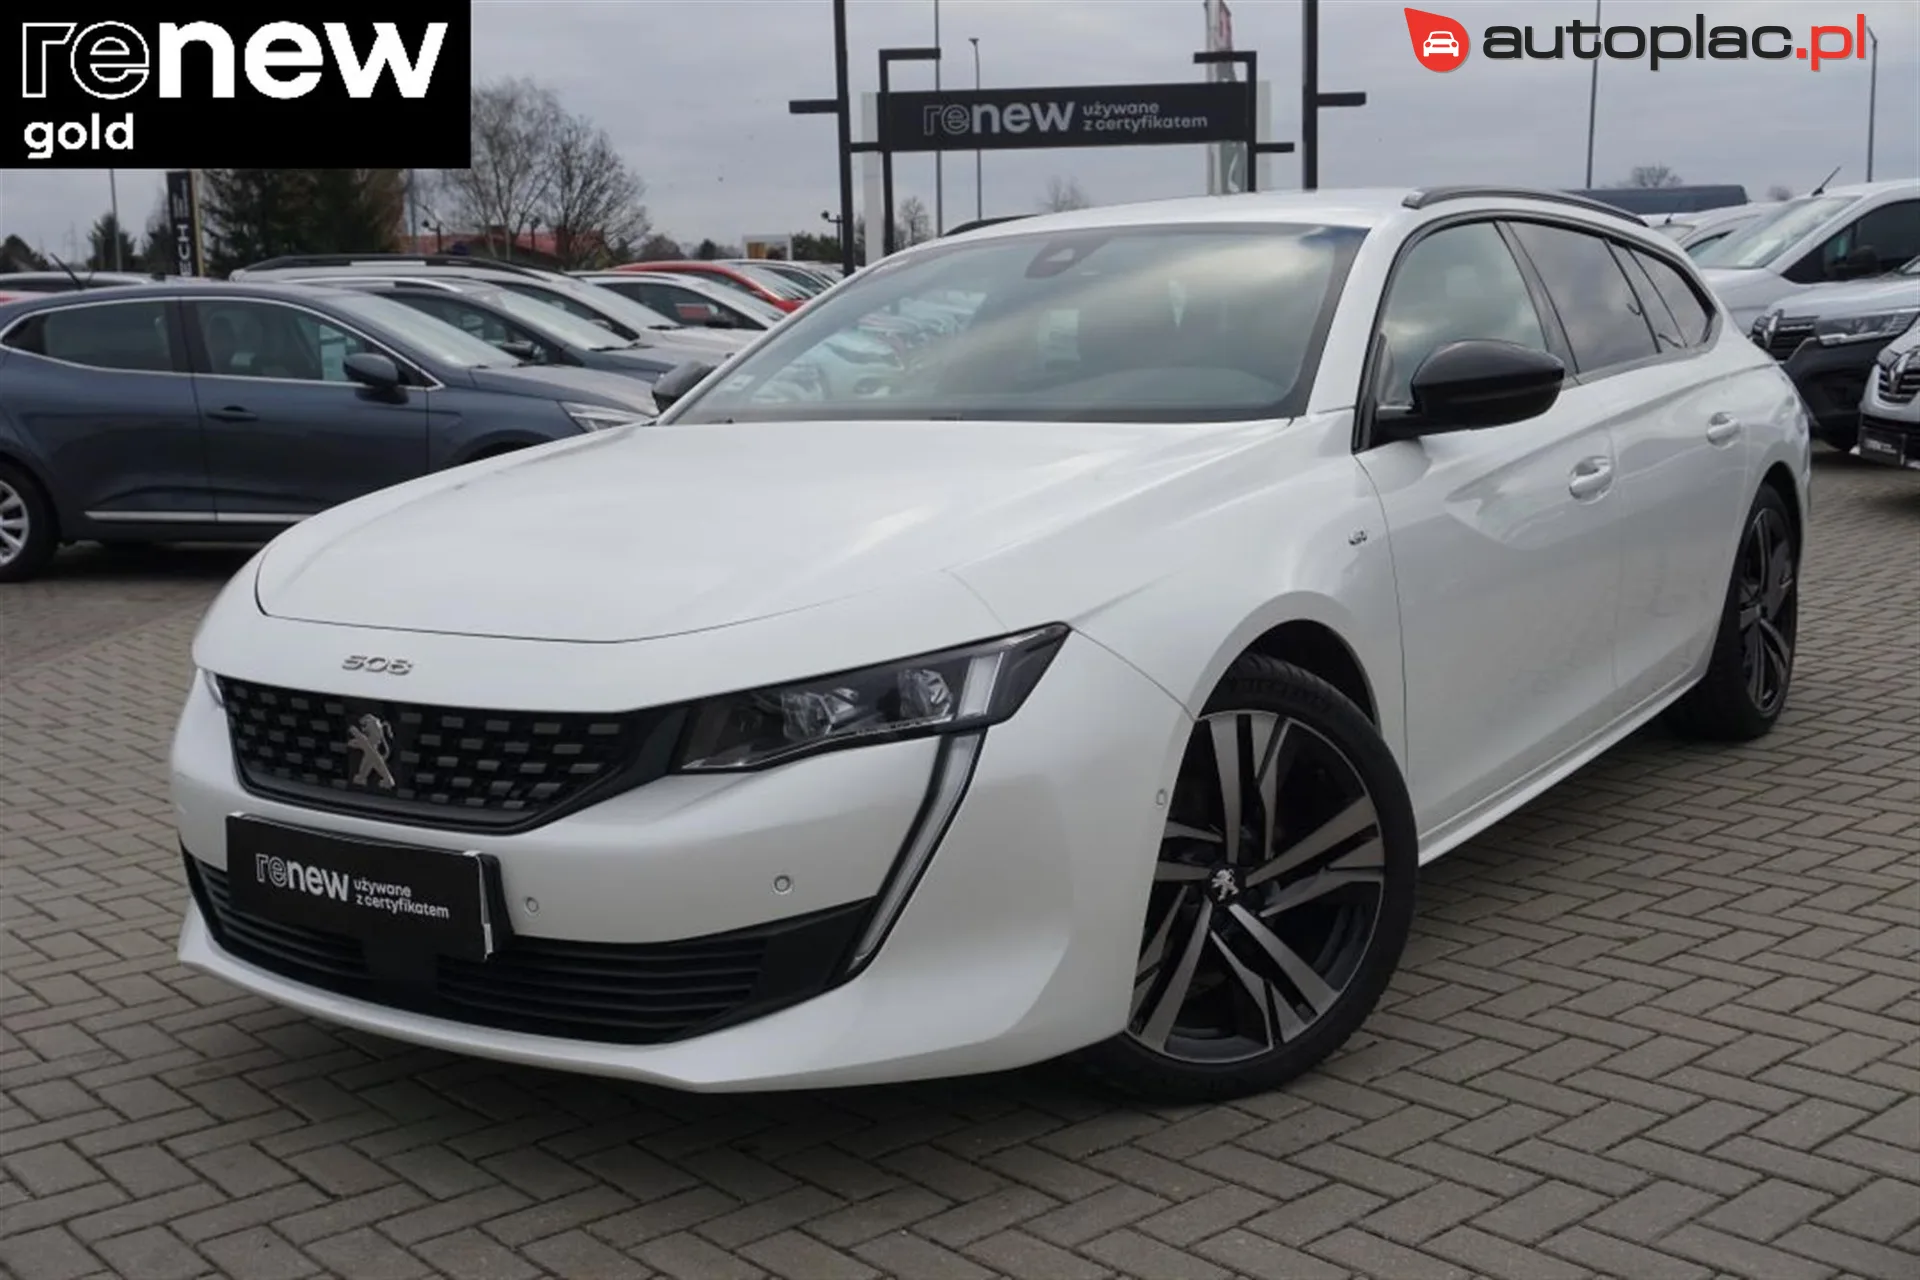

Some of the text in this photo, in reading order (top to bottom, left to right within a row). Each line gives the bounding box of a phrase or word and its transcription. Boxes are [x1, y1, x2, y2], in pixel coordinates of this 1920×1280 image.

[923, 101, 1075, 136] renew
[1083, 101, 1159, 118] używane
[1095, 114, 1208, 134] certyfikatem
[341, 654, 413, 677] 508
[255, 853, 349, 902] renew
[353, 877, 412, 898] używane
[364, 897, 449, 919] certyfikatem
